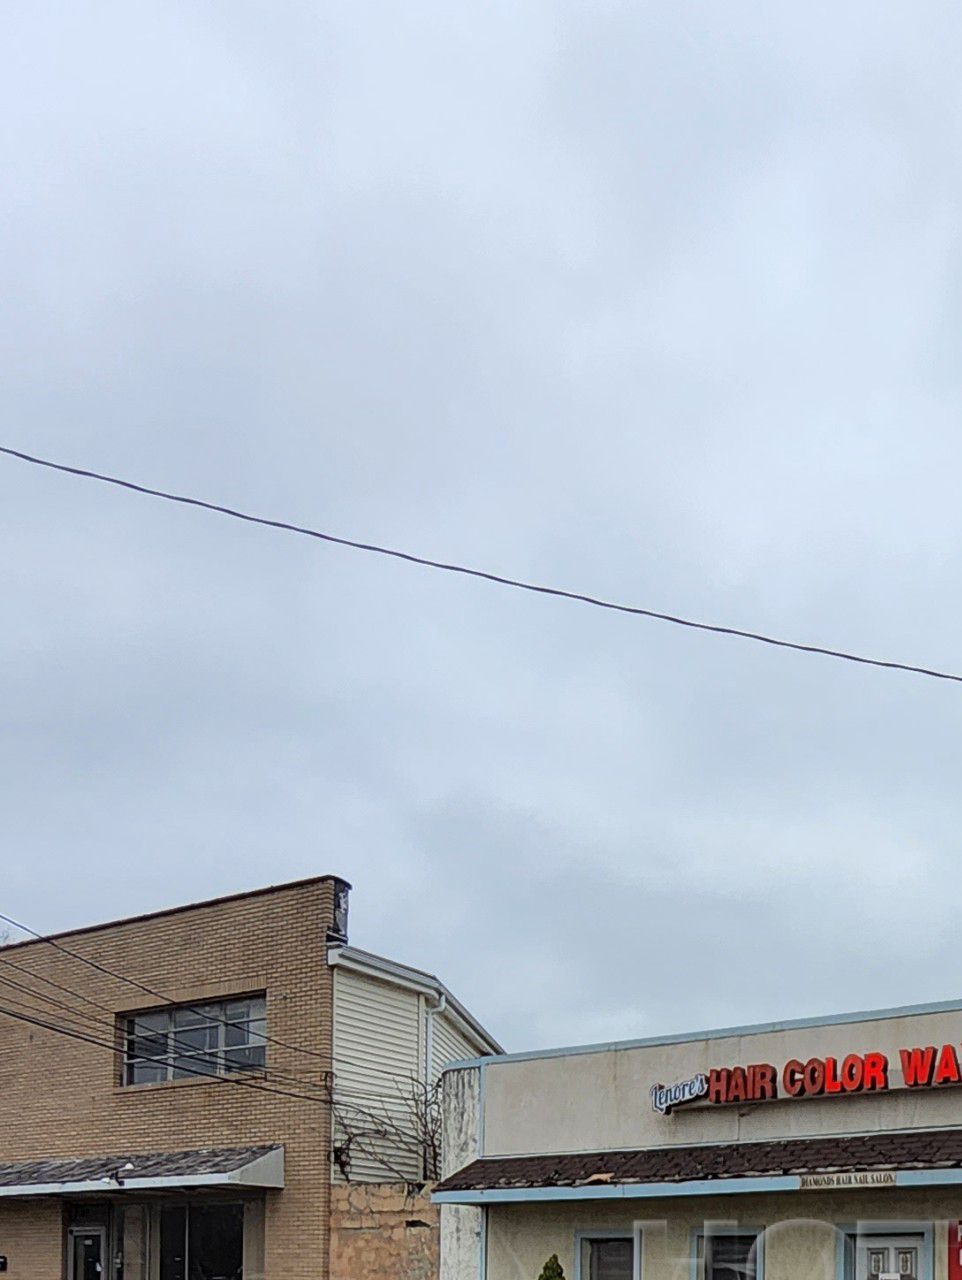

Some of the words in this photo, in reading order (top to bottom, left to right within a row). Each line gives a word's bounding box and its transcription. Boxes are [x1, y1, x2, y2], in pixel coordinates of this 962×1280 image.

[651, 1074, 708, 1113] Lenore's
[709, 1063, 777, 1104] HAIR
[782, 1052, 888, 1097] COLOR
[870, 1172, 895, 1184] SALON
